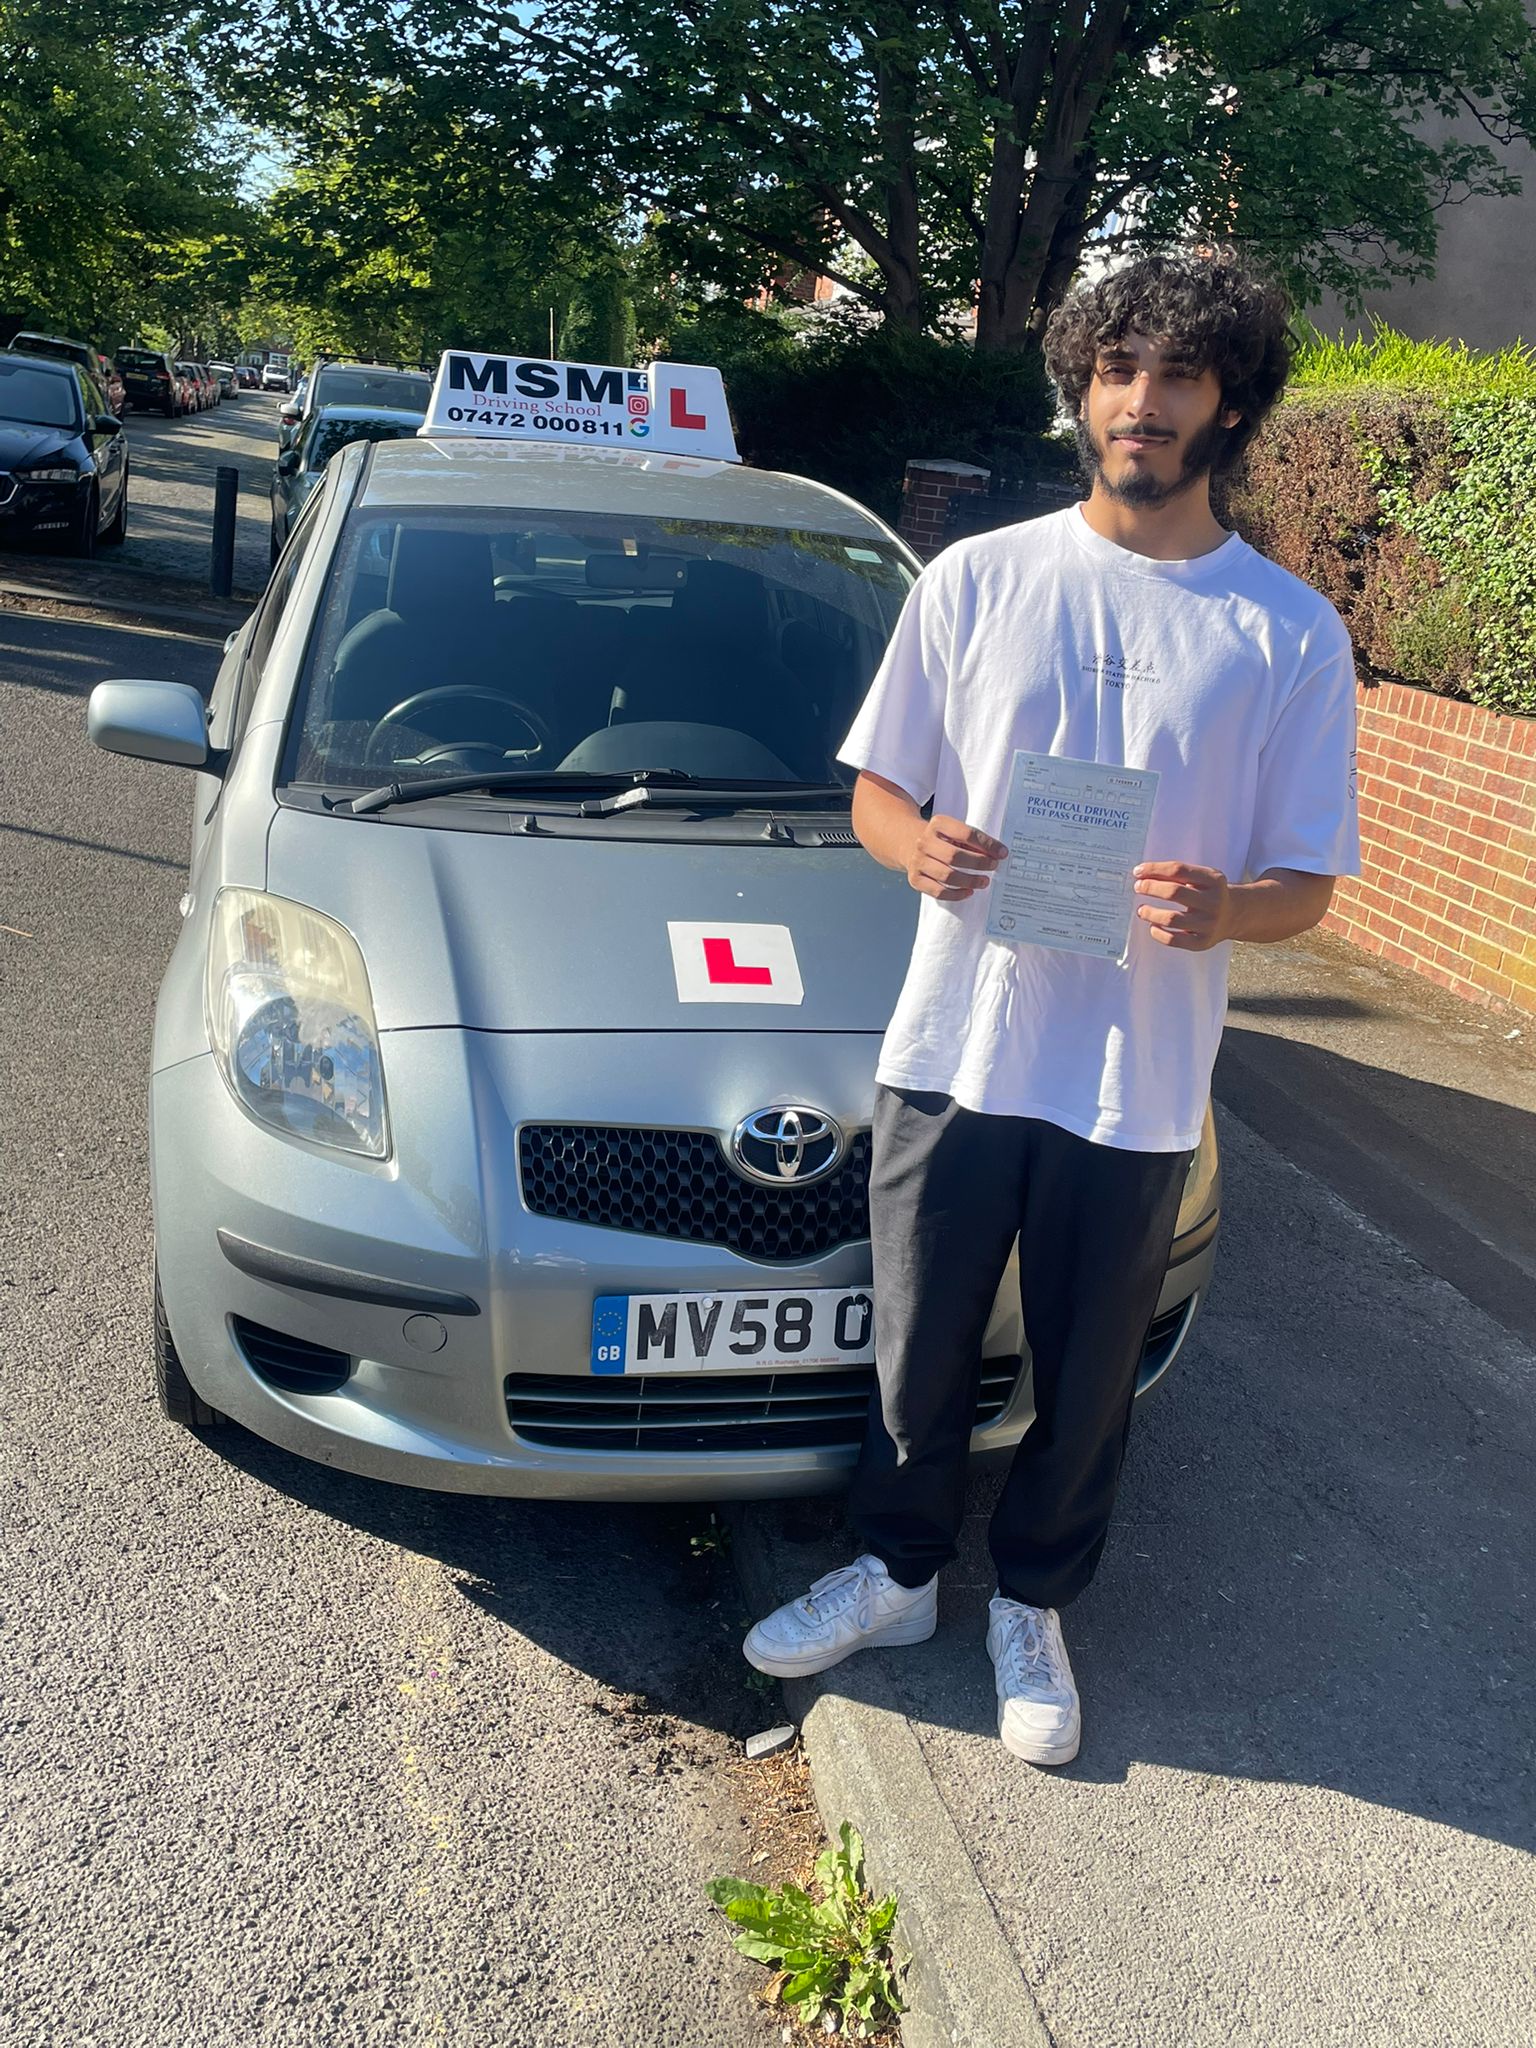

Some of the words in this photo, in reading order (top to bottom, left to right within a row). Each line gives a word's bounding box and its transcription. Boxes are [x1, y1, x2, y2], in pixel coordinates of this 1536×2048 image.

[449, 355, 624, 405] MSM
[473, 394, 540, 415] Driving
[545, 401, 602, 417] School
[670, 388, 706, 430] L
[448, 407, 525, 428] 07472
[533, 415, 623, 436] 000811
[1105, 679, 1131, 690] TOKYO
[1027, 796, 1081, 813] PRACTICAL
[1084, 805, 1130, 821] DRIVING
[1027, 806, 1046, 817] TEST
[1049, 810, 1070, 820] PASS
[1072, 813, 1129, 830] CERTIFICATE
[702, 938, 773, 985] L
[637, 1297, 813, 1360] MV58
[597, 1345, 620, 1361] GB
